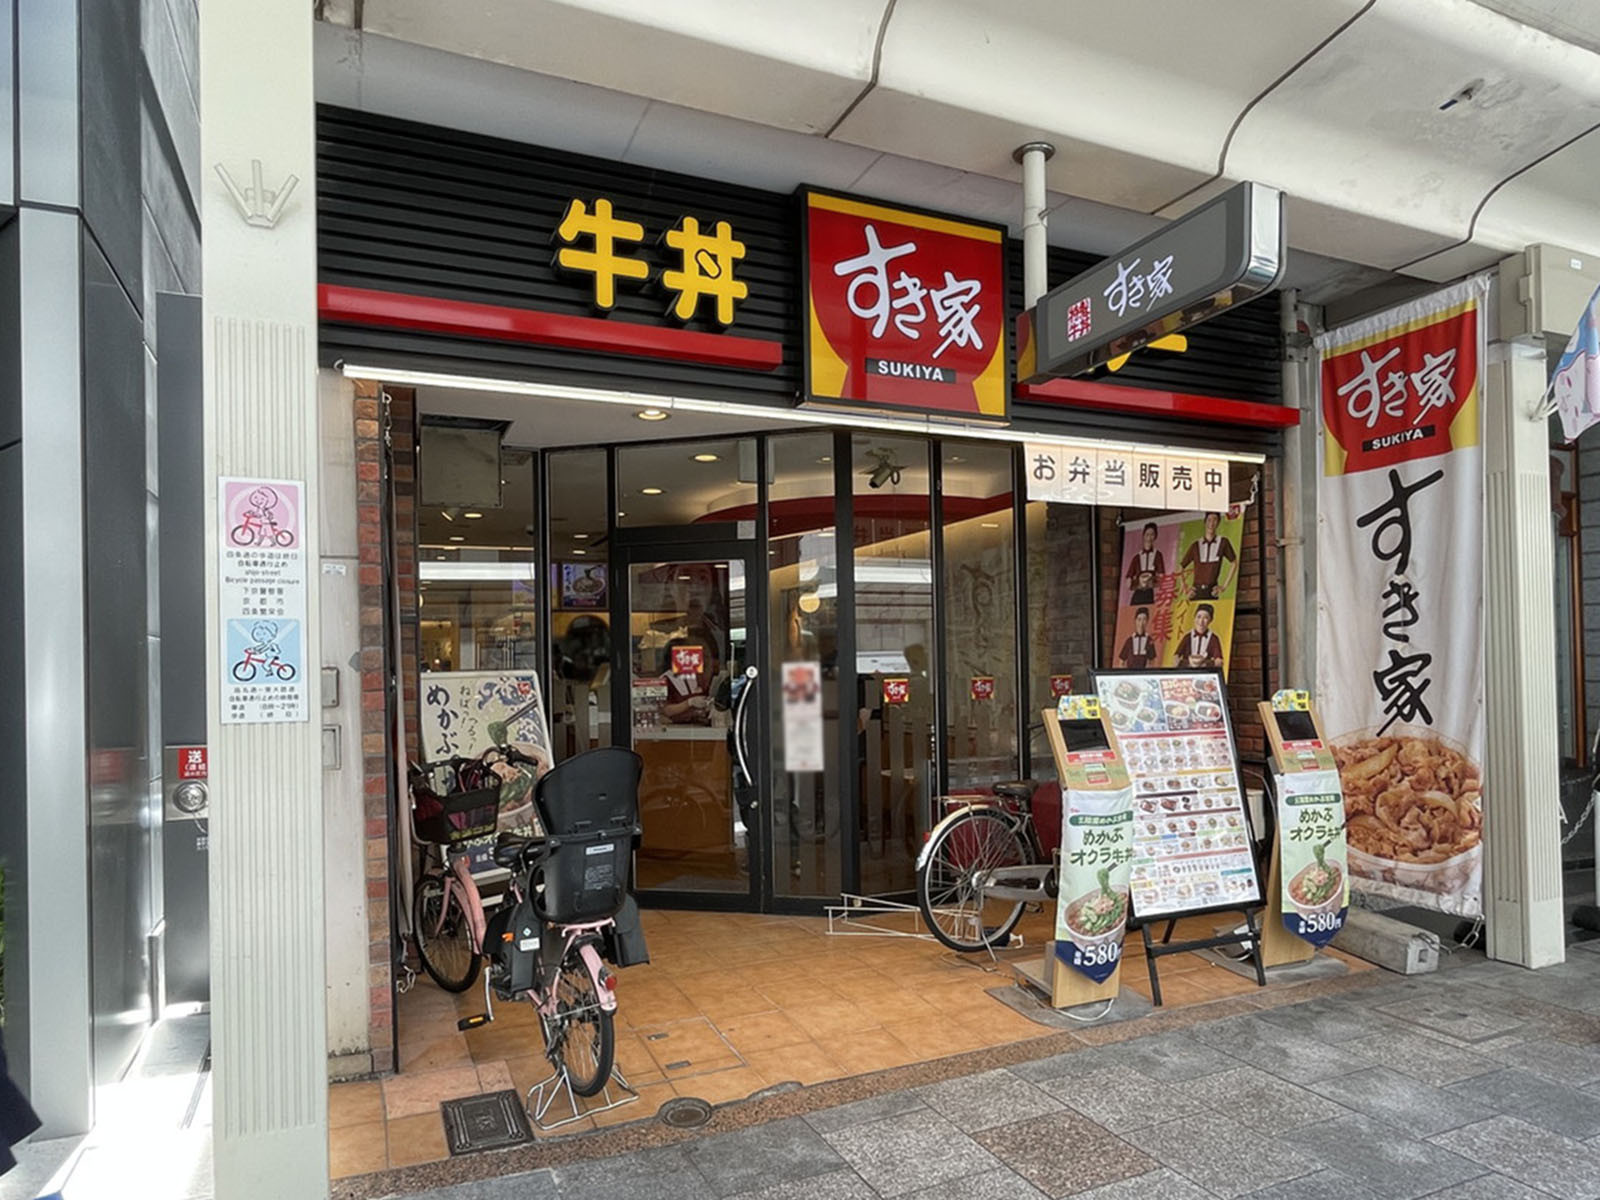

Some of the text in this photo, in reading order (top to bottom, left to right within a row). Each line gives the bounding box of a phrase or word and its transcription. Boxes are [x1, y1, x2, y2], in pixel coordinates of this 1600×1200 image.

[557, 198, 749, 326] 牛丼
[834, 223, 984, 359] すき家
[1103, 255, 1174, 318] すき家
[877, 360, 945, 382] SUKIYA
[1337, 345, 1458, 429] すき家
[1371, 428, 1425, 451] SUKIYA
[1032, 454, 1223, 494] お弁当販売中
[1355, 468, 1445, 738] すき家
[426, 684, 459, 755] めかぶ
[187, 750, 203, 764] 送
[1299, 807, 1334, 823] めかぶ
[1082, 826, 1124, 846] めかぶ
[1083, 941, 1120, 967] 580
